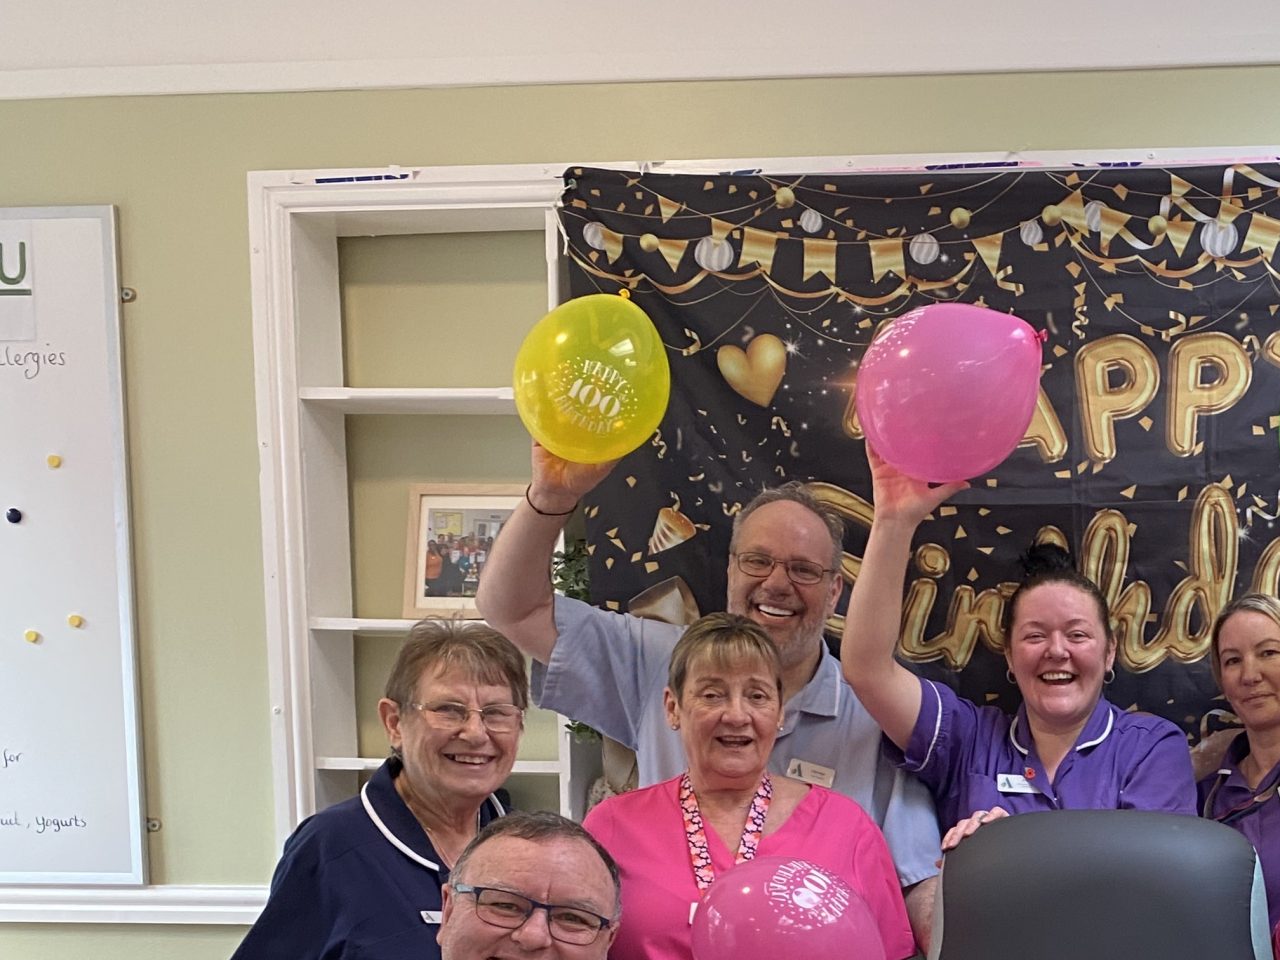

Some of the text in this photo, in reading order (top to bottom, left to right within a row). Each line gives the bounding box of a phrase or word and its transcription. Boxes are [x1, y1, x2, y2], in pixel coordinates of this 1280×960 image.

[582, 359, 628, 392] HAPPY
[2, 748, 23, 769] for
[822, 886, 851, 924] HAPPY
